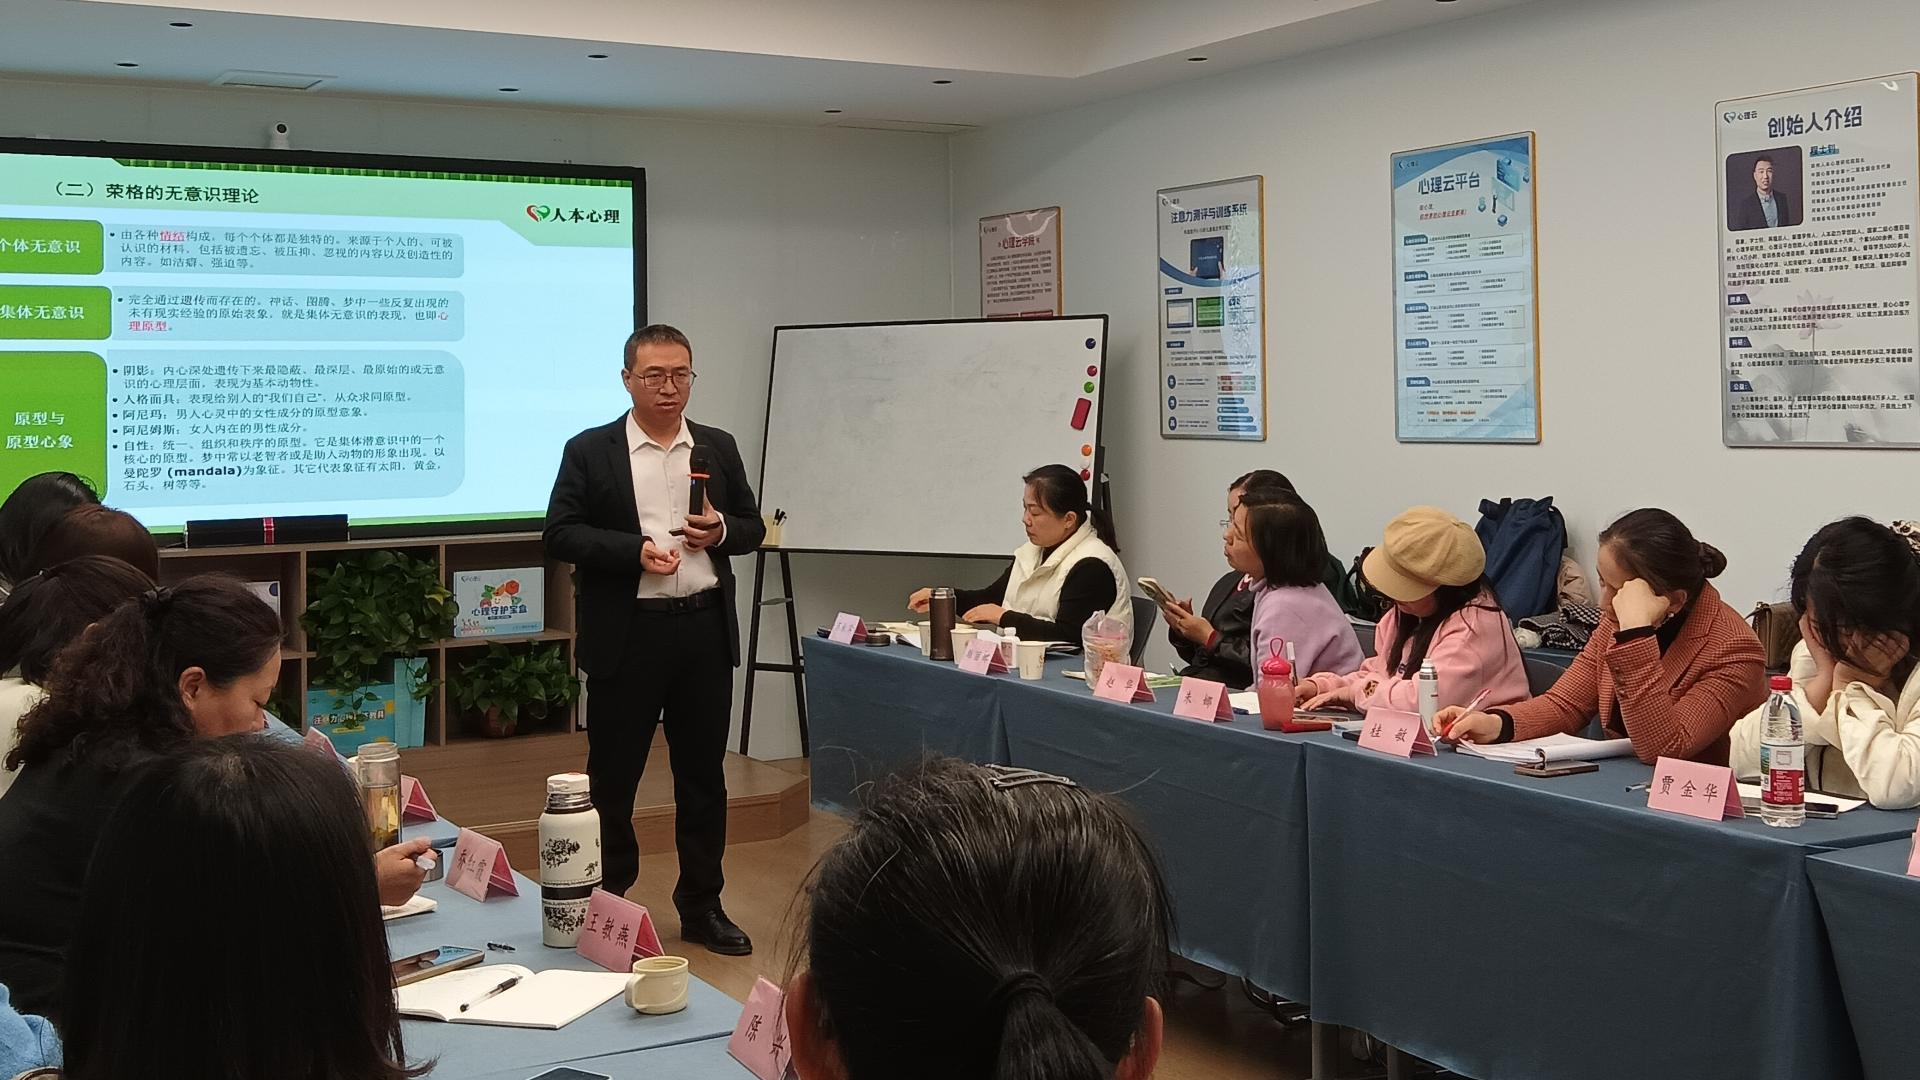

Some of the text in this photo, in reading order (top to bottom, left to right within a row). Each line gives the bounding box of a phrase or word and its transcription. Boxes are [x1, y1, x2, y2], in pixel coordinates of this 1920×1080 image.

[1737, 110, 1757, 121] 心理云
[1767, 105, 1863, 138] 创始人介绍
[1418, 171, 1480, 195] 心理云平台
[550, 207, 620, 224] 人本心理
[1170, 203, 1248, 223] 注意力测评与训练系统
[0, 239, 81, 254] 个体无意识
[0, 305, 85, 320] 集体无意识
[14, 411, 65, 426] 原型与
[5, 434, 74, 449] 原型心象
[472, 604, 528, 616] 心理守护宝盒
[1659, 775, 1718, 803] 贾金华
[586, 913, 630, 949] 王敏燕
